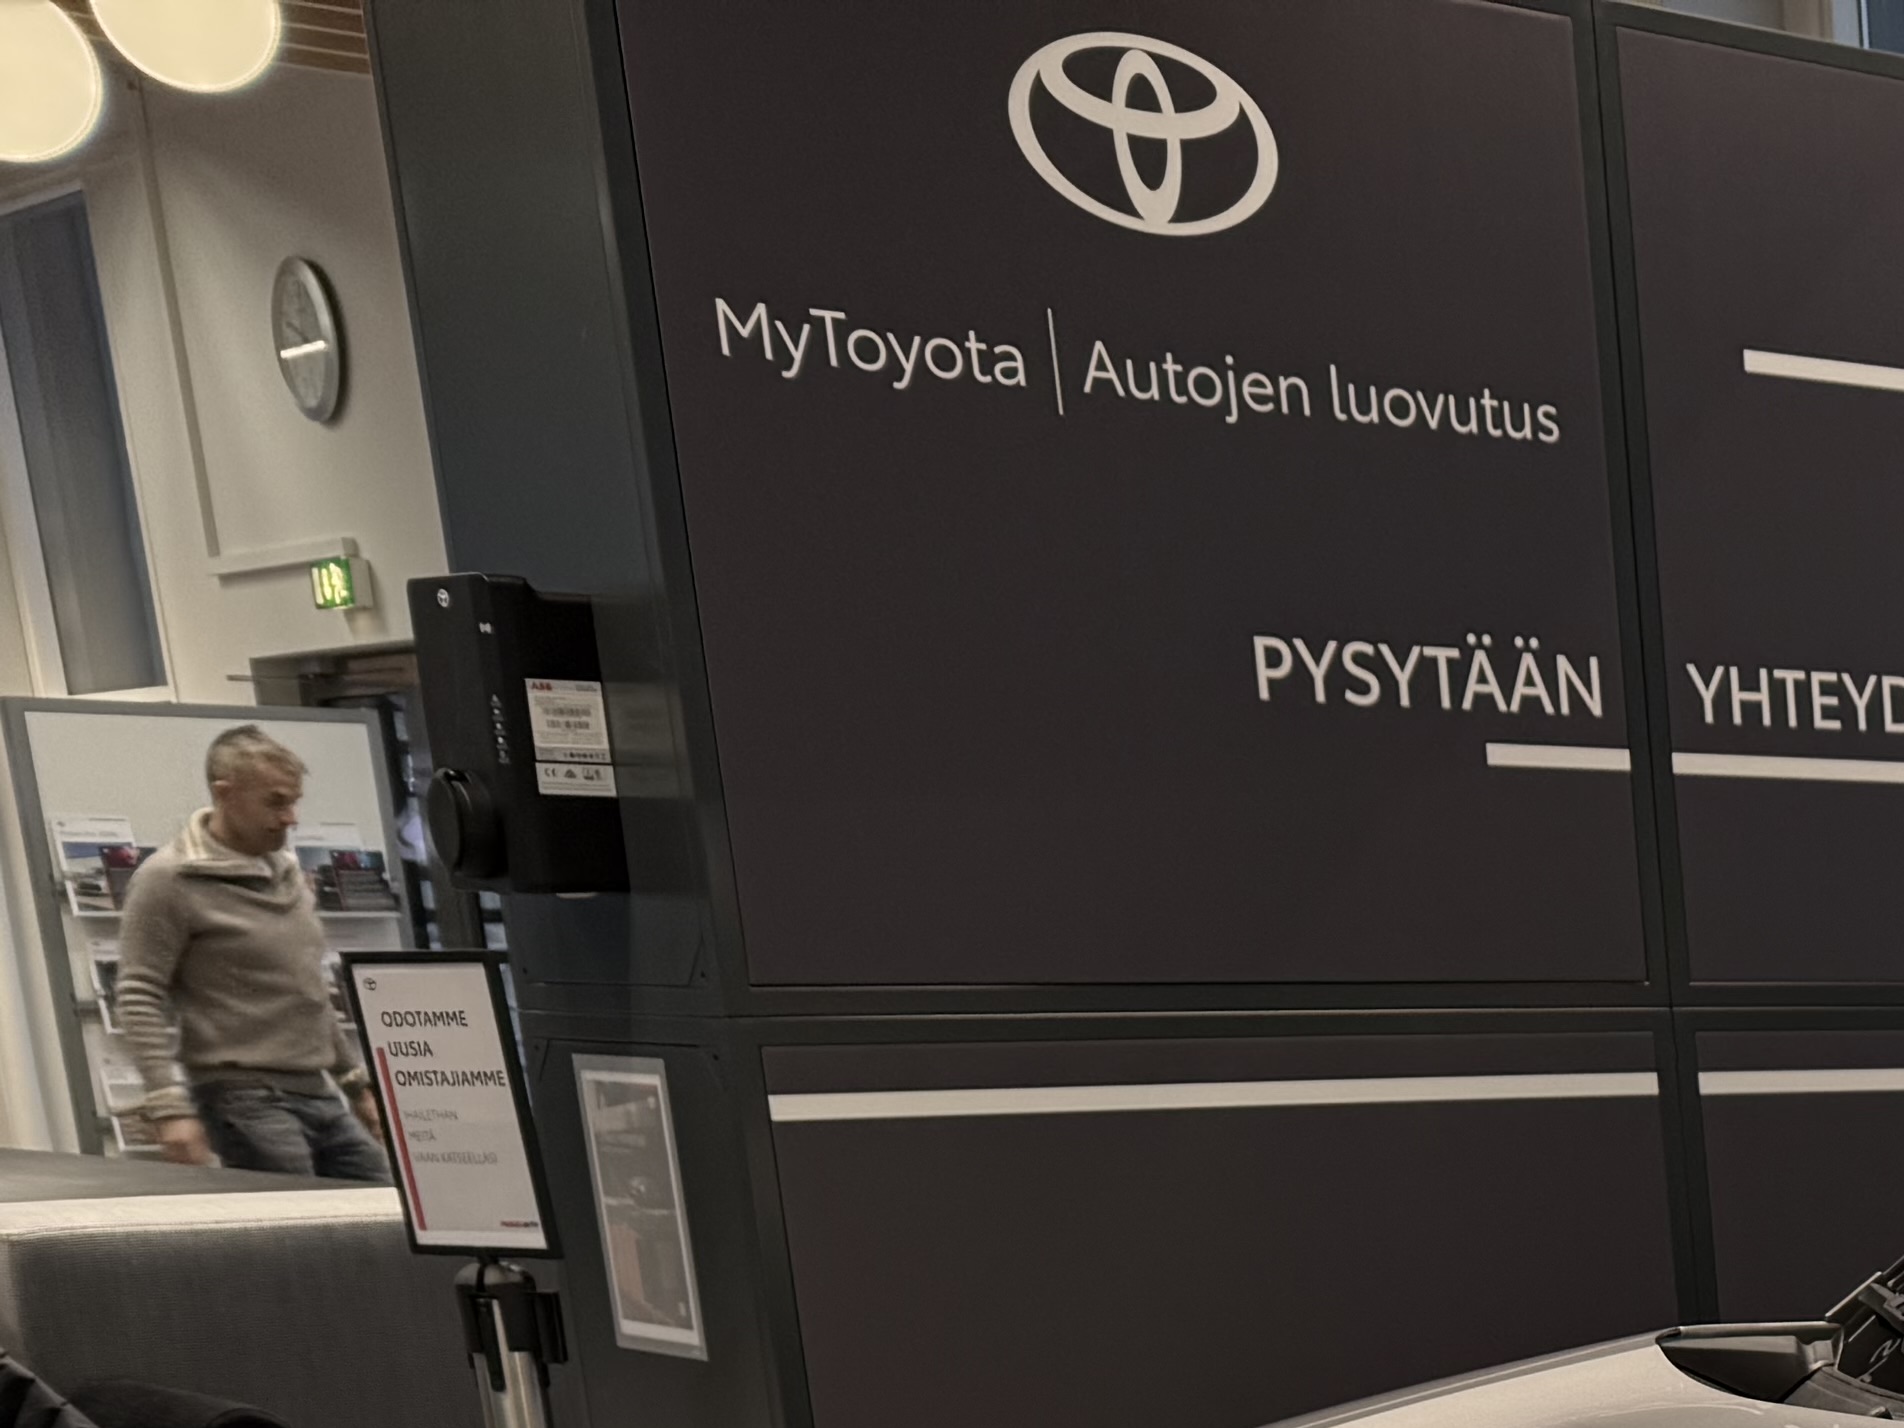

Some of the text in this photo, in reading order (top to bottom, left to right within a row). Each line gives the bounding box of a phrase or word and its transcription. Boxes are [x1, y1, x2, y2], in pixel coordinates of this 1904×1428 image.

[713, 296, 1561, 444] MyToyota Autojen luovutus
[1253, 632, 1603, 718] PYSYTÄÄN
[381, 1010, 469, 1028] ODOTAMME
[387, 1040, 434, 1058] UUSIA
[394, 1069, 506, 1088] OMISTAJIAMME
